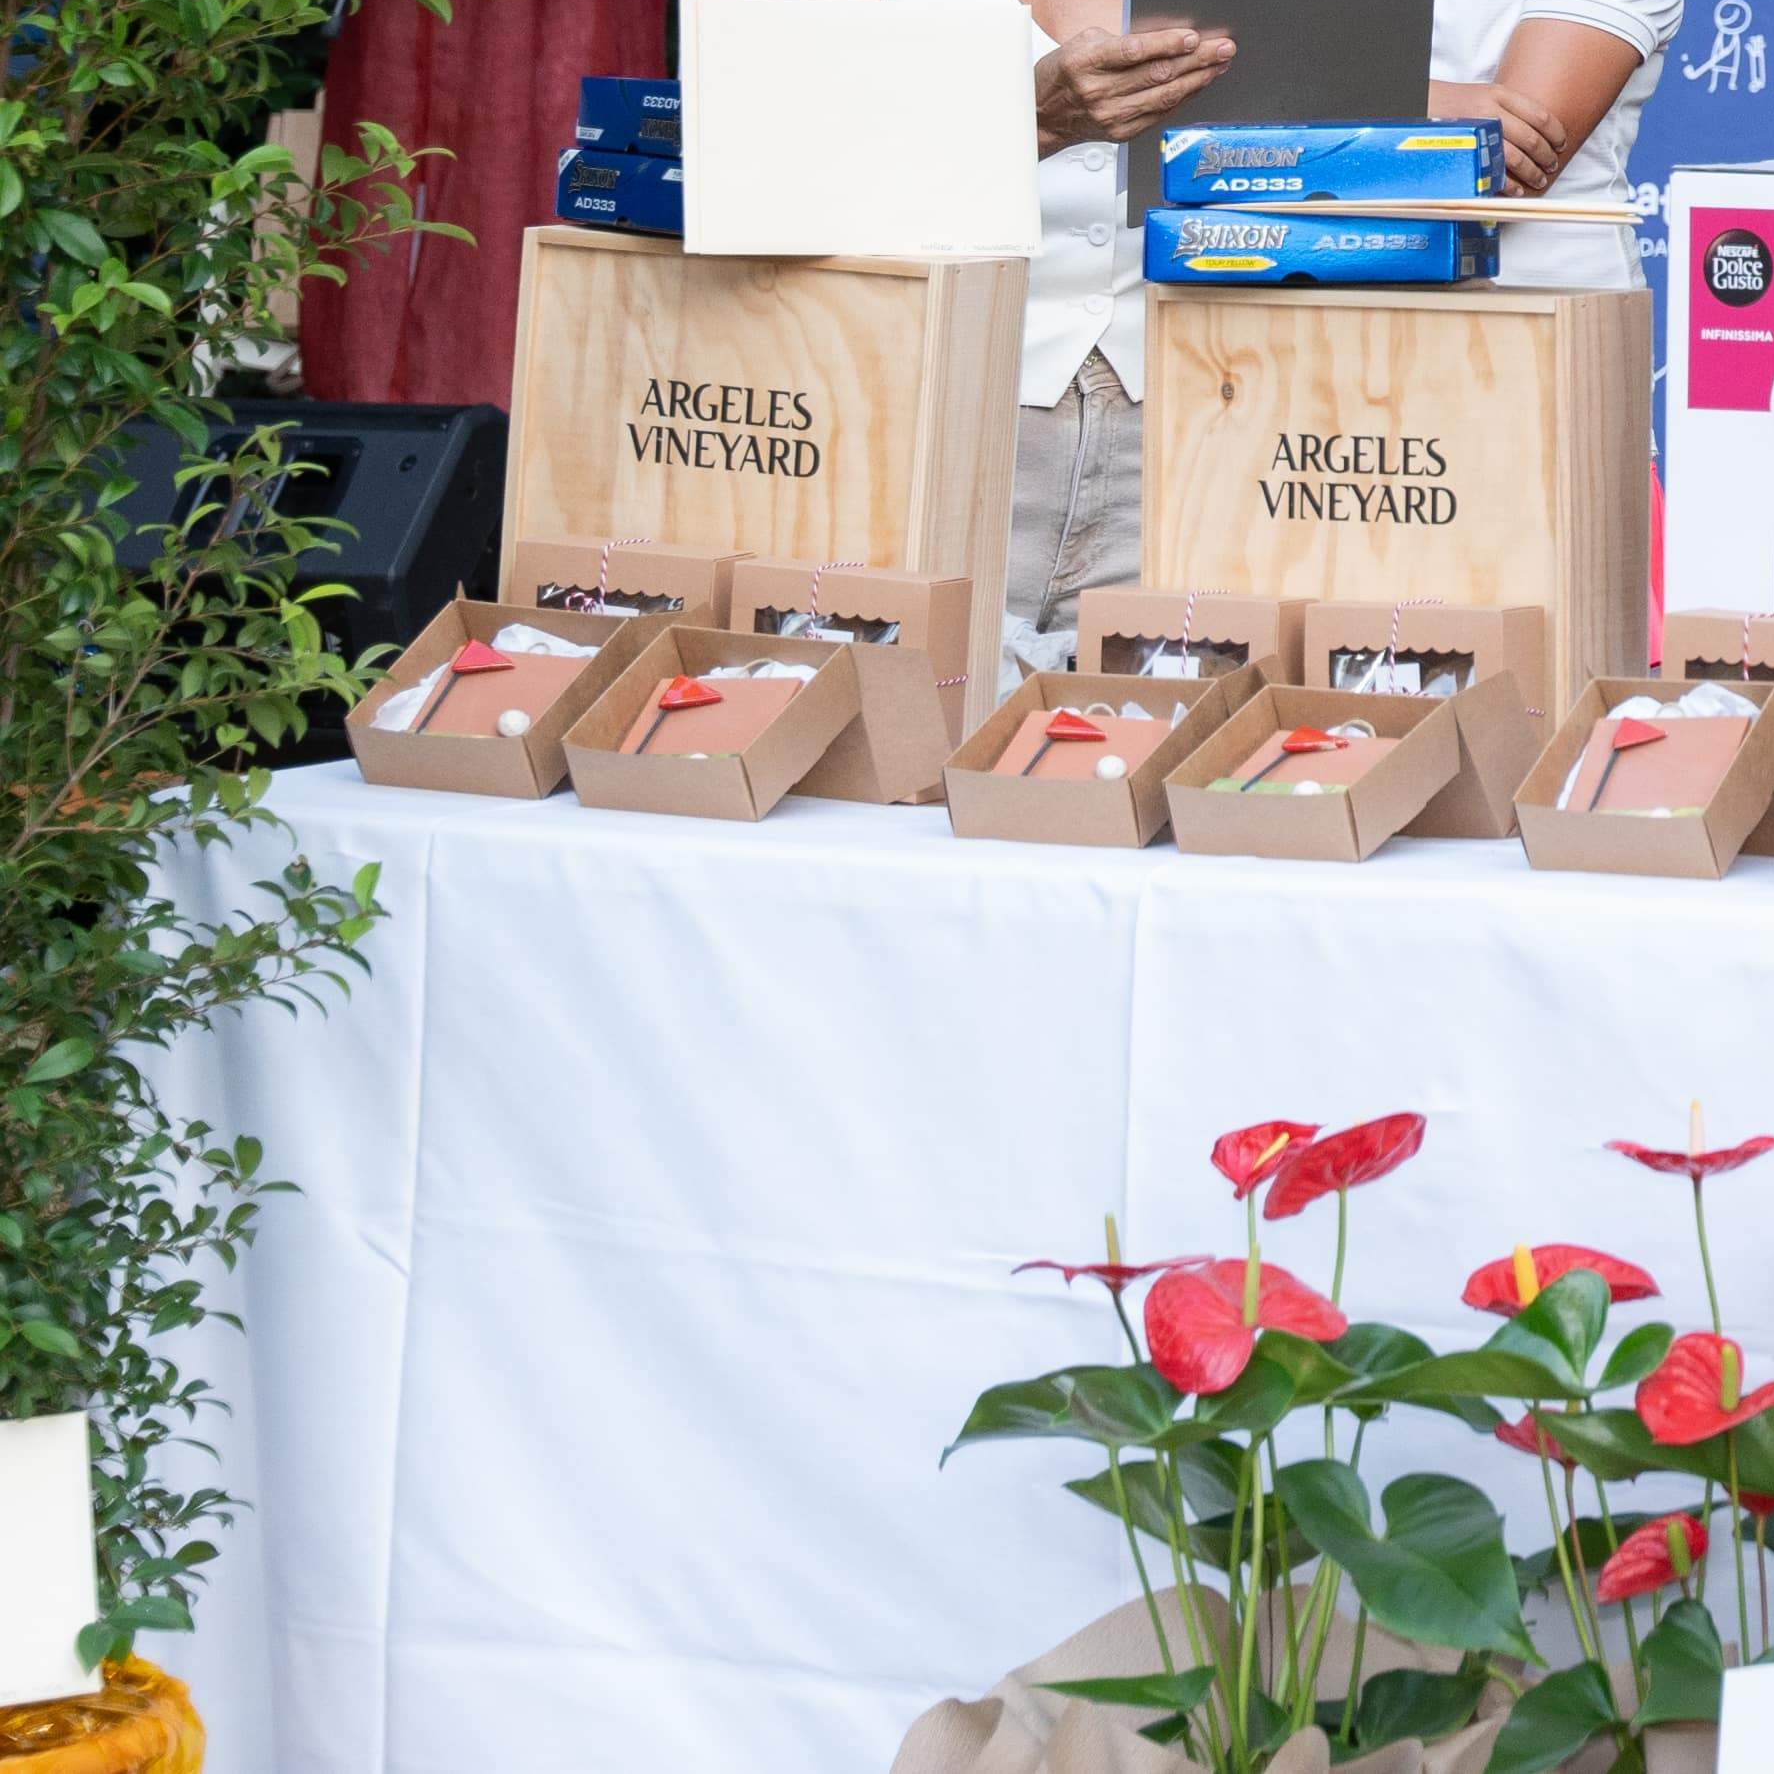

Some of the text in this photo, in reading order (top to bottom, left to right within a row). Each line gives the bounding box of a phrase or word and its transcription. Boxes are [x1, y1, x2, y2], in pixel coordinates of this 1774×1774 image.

[1168, 136, 1190, 155] NEW
[1194, 140, 1304, 178] SRIXON
[1210, 178, 1304, 192] AD333
[573, 196, 617, 212] AD333
[1172, 218, 1430, 259] SRIXON AD333
[1712, 256, 1763, 277] Dolce
[1712, 273, 1764, 291] Gusto
[1701, 327, 1774, 343] INFINISSIMA
[640, 377, 813, 431] ARGELES
[626, 422, 821, 478] VINEYARD
[1271, 432, 1447, 478] ARGELES
[1257, 479, 1458, 526] VINEYARD
